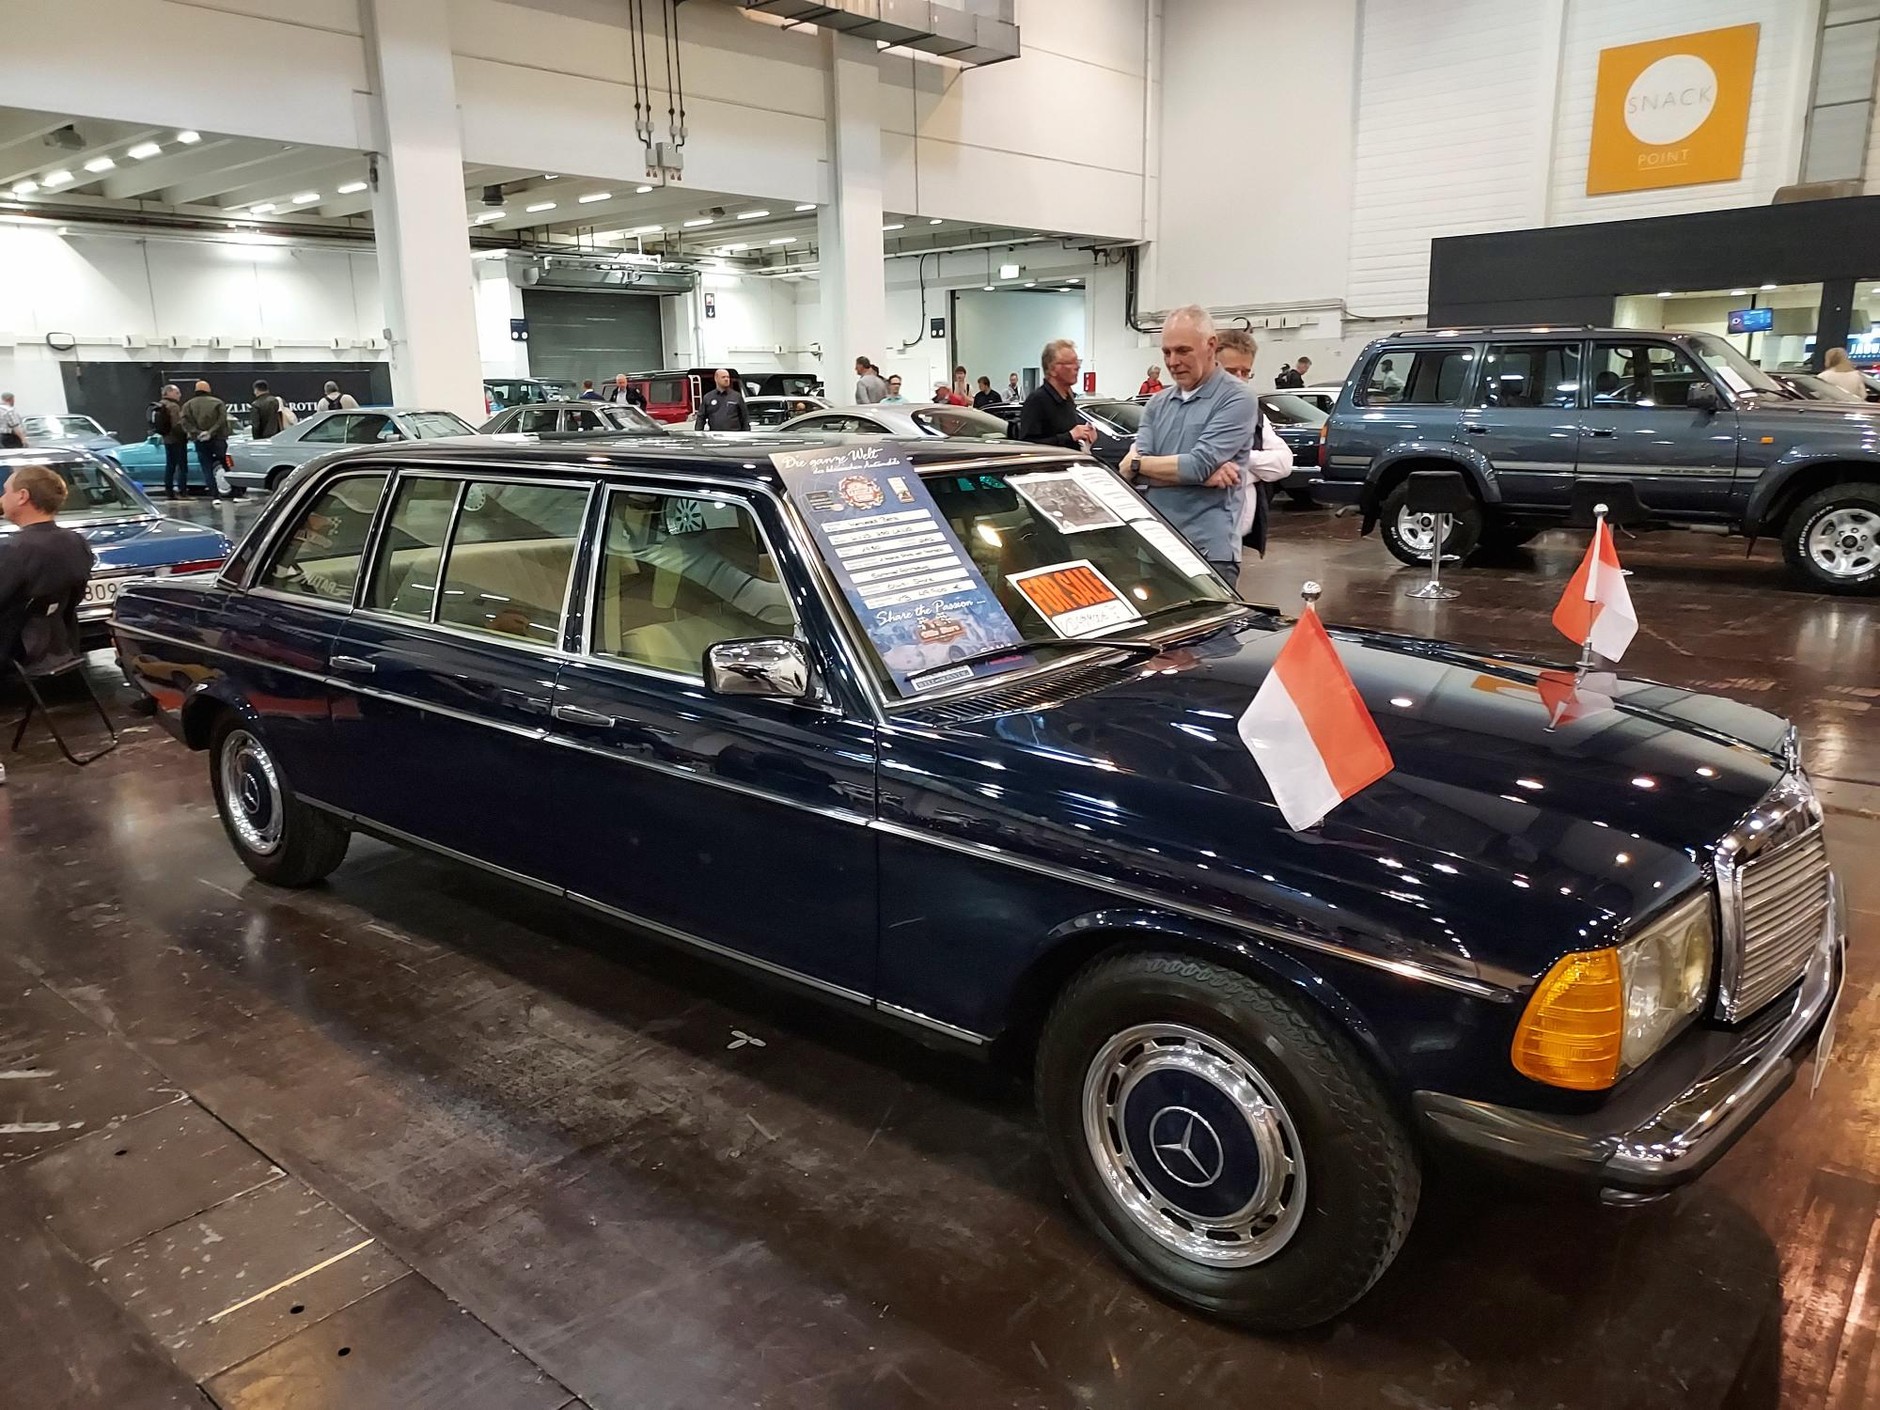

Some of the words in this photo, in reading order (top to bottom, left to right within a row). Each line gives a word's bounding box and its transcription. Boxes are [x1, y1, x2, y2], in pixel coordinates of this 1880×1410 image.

[1627, 85, 1713, 114] SNACK
[1637, 149, 1690, 166] POINT
[782, 455, 807, 469] Die
[809, 456, 848, 467] ganze
[847, 447, 884, 461] Welt
[1017, 575, 1078, 616] FOR
[1053, 566, 1117, 606] SALE
[876, 610, 913, 627] Share
[915, 606, 932, 617] the
[932, 599, 974, 614] Passion
